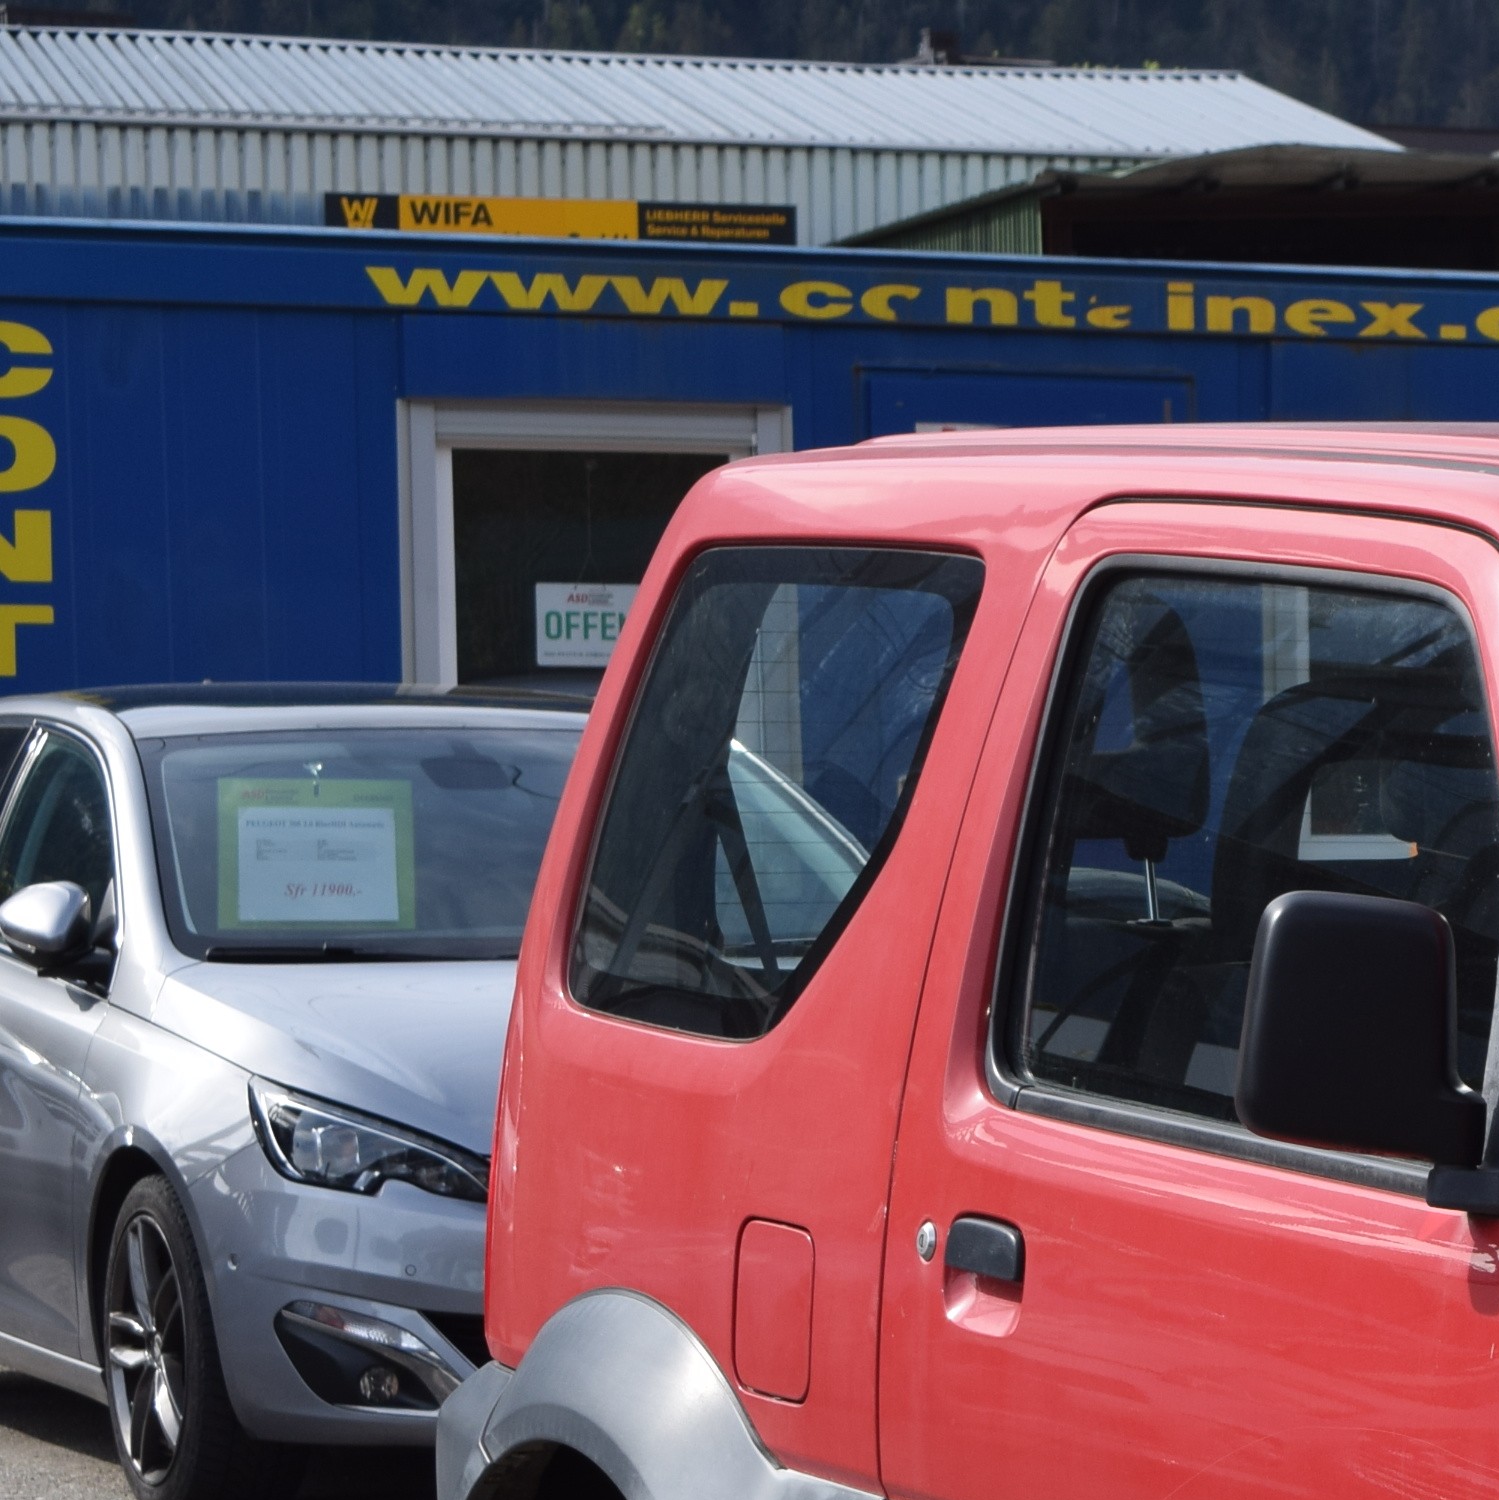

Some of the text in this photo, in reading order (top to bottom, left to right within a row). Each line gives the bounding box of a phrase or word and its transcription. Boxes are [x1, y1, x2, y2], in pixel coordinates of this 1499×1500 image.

[411, 201, 493, 226] WIFA
[646, 210, 786, 225] LIEBHERR Servicestelle
[647, 225, 688, 237] Service
[702, 226, 770, 239] Reparaturen
